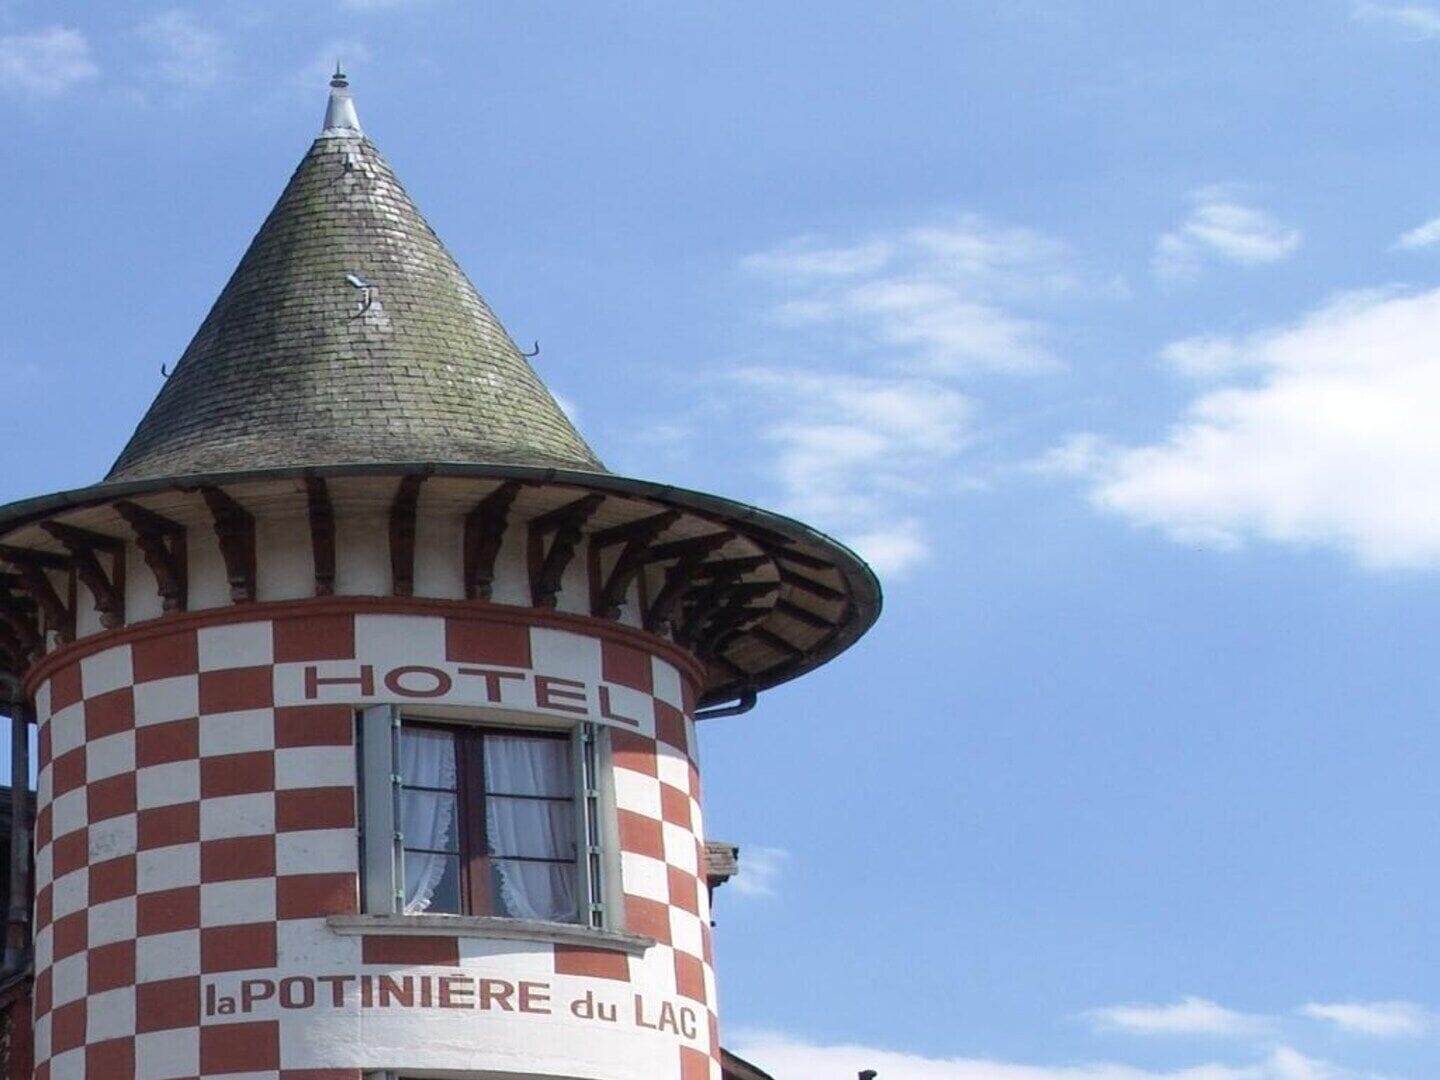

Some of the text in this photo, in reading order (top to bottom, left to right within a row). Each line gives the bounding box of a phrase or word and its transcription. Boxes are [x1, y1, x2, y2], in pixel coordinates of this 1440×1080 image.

[304, 665, 639, 727] HOTEL
[570, 991, 617, 1022] du
[634, 994, 697, 1041] LAC
